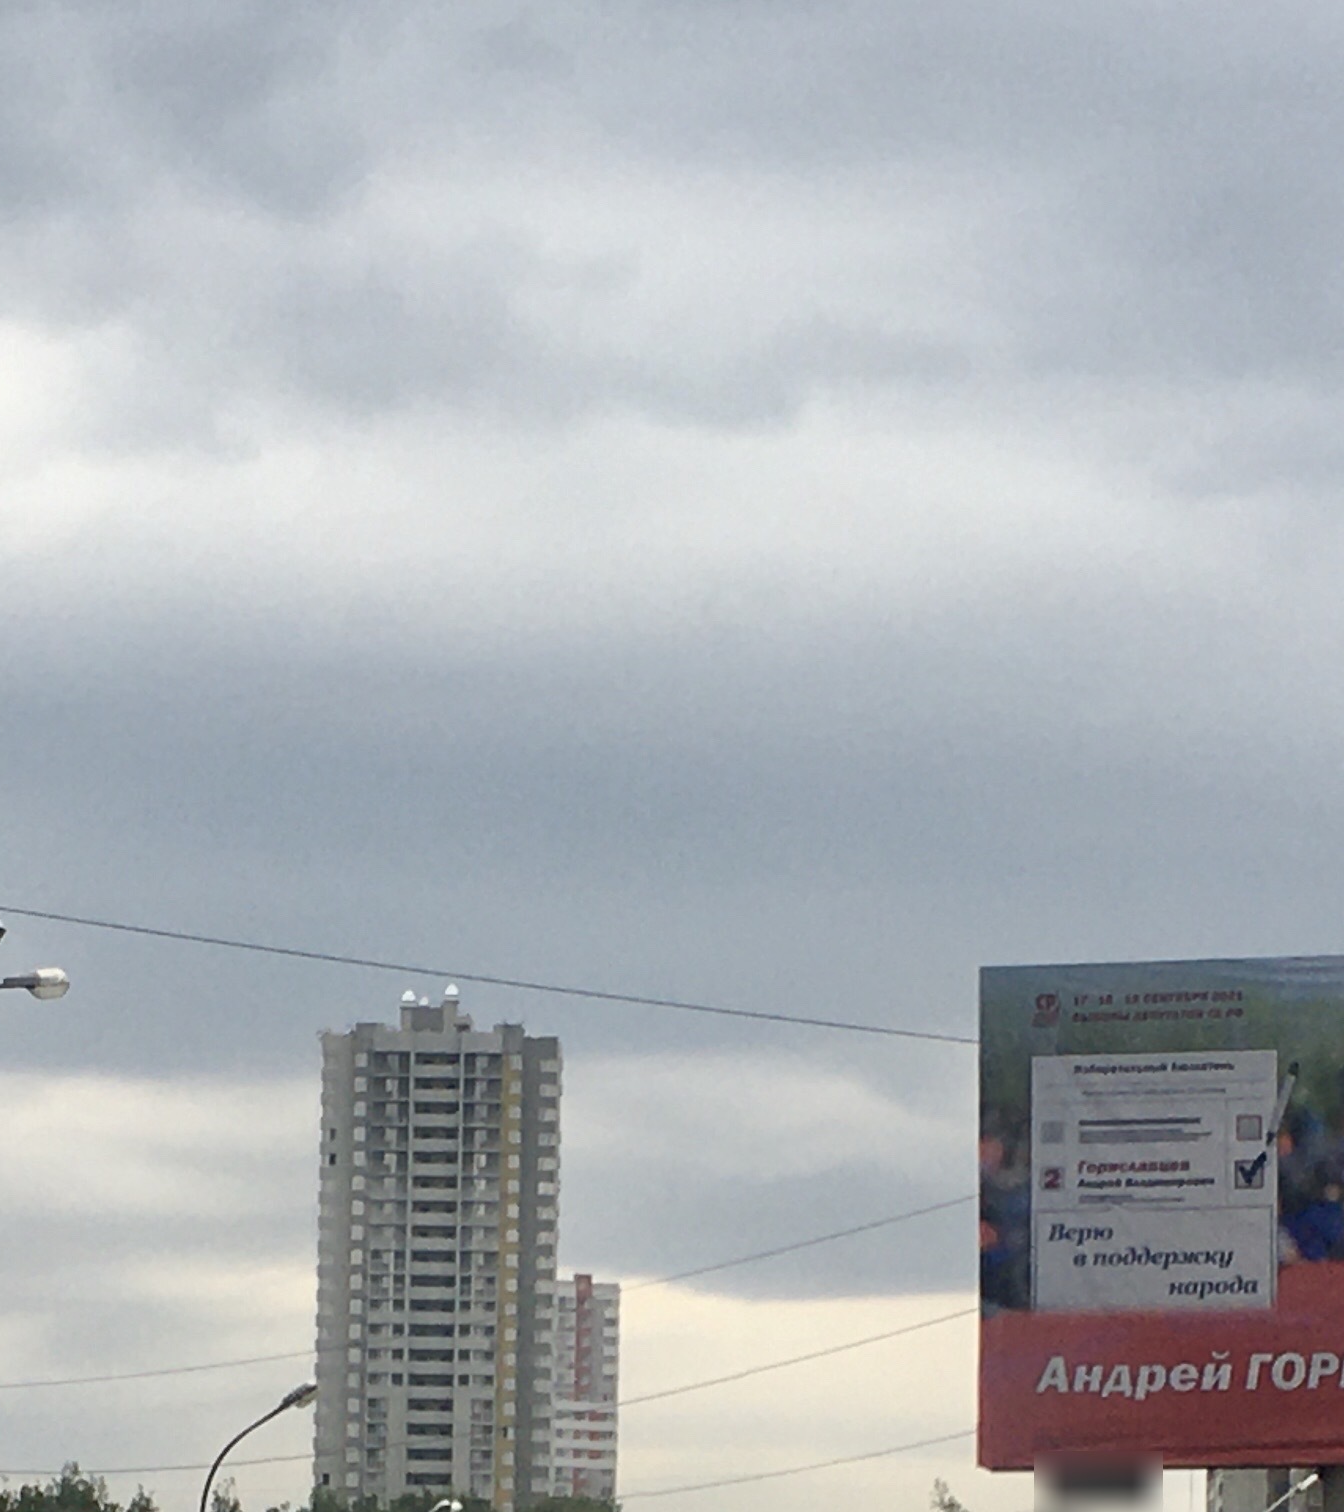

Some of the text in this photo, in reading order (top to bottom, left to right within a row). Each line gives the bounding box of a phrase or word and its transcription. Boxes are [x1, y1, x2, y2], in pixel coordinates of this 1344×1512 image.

[1044, 1168, 1062, 1189] 2
[1077, 1160, 1191, 1175] Гориславцев
[1048, 1223, 1114, 1246] Верю
[1073, 1247, 1234, 1270] в поддержку
[1168, 1275, 1259, 1299] народа
[1036, 1350, 1233, 1400] Андрей
